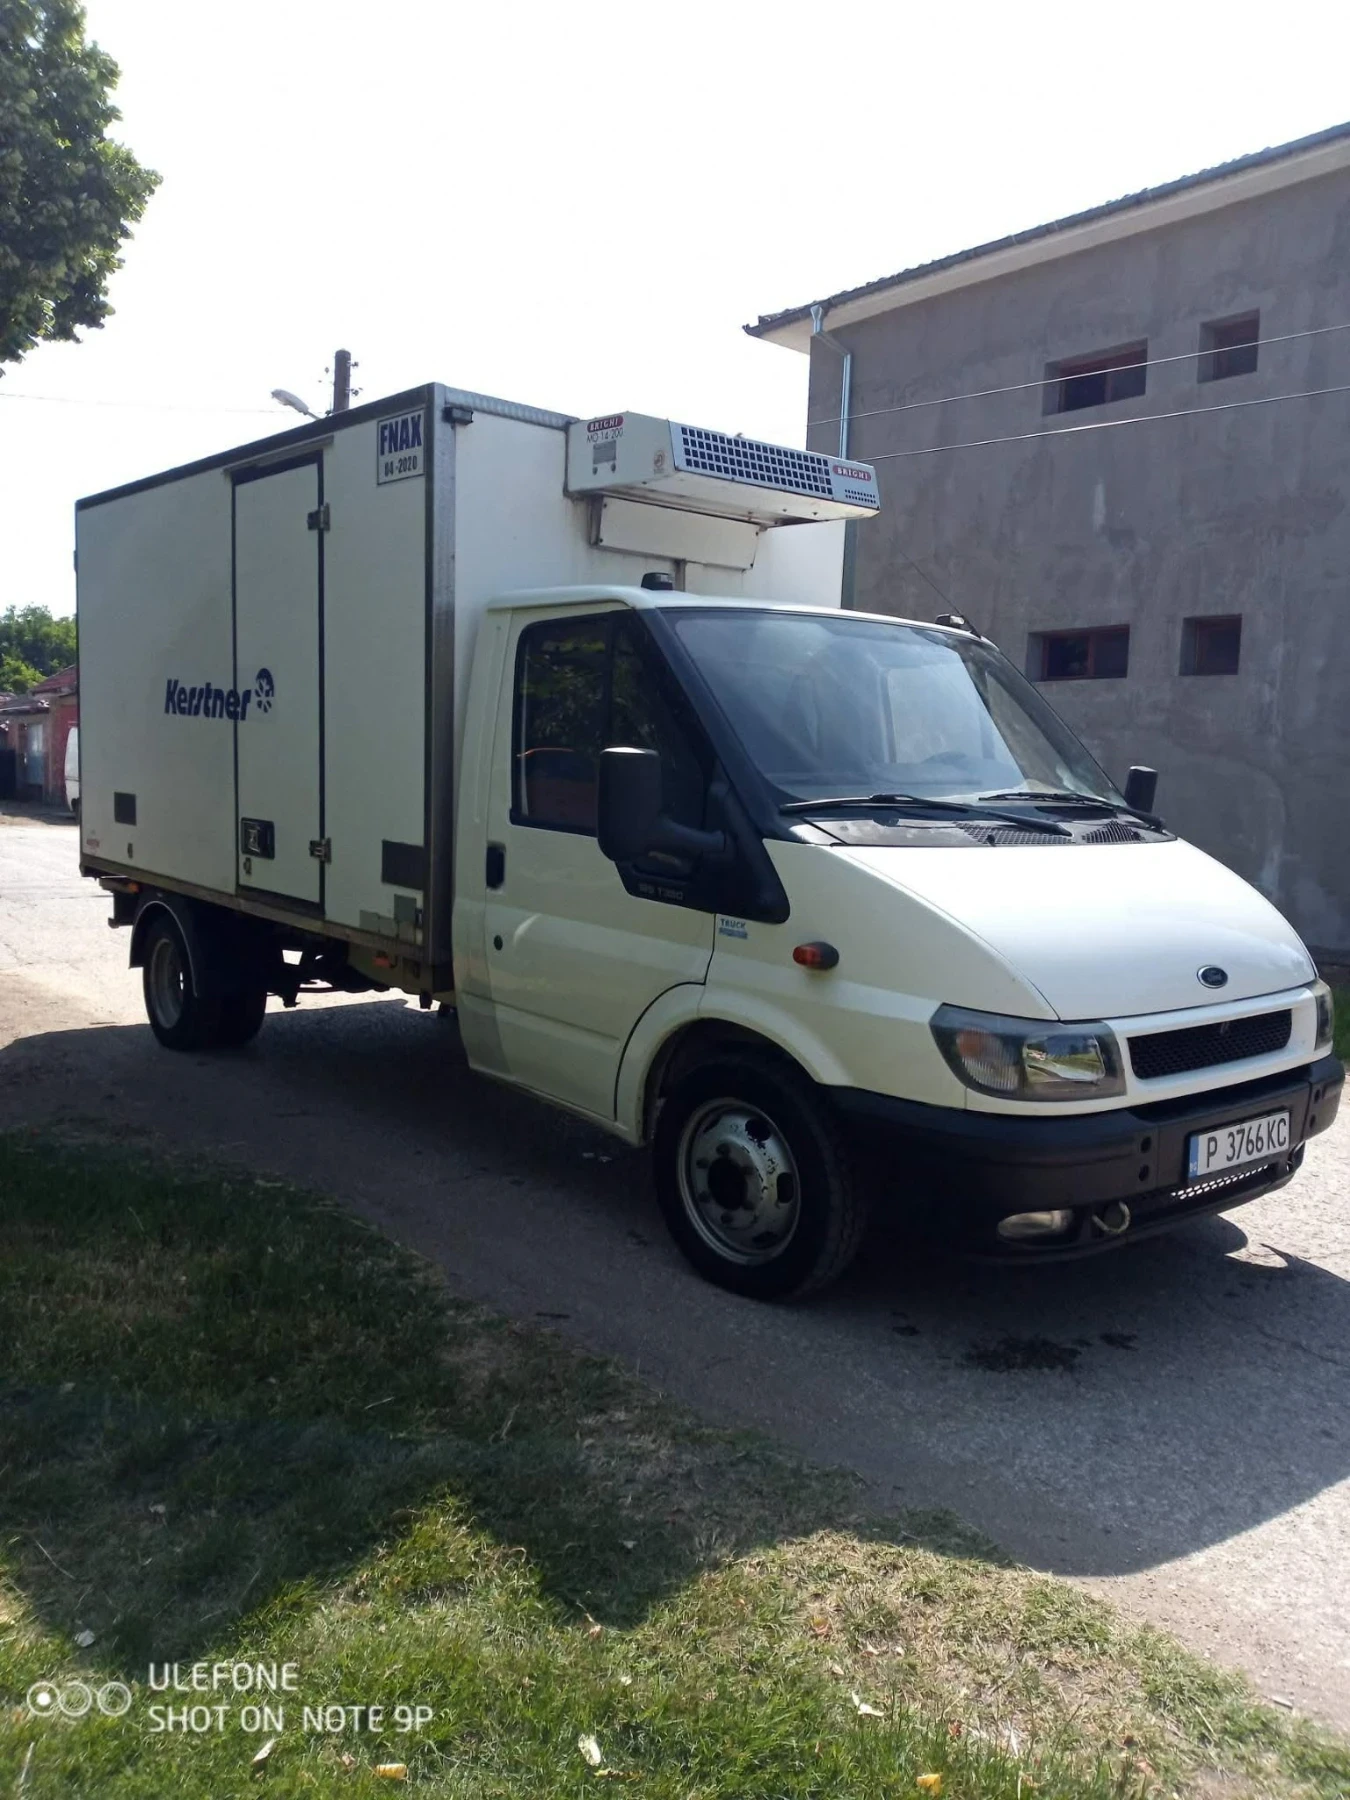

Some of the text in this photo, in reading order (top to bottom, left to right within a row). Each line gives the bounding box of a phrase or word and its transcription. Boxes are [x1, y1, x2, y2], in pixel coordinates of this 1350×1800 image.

[380, 414, 422, 456] FNAX
[164, 678, 252, 721] Kerstner
[720, 918, 746, 929] TRUCK
[1206, 1136, 1218, 1168] P
